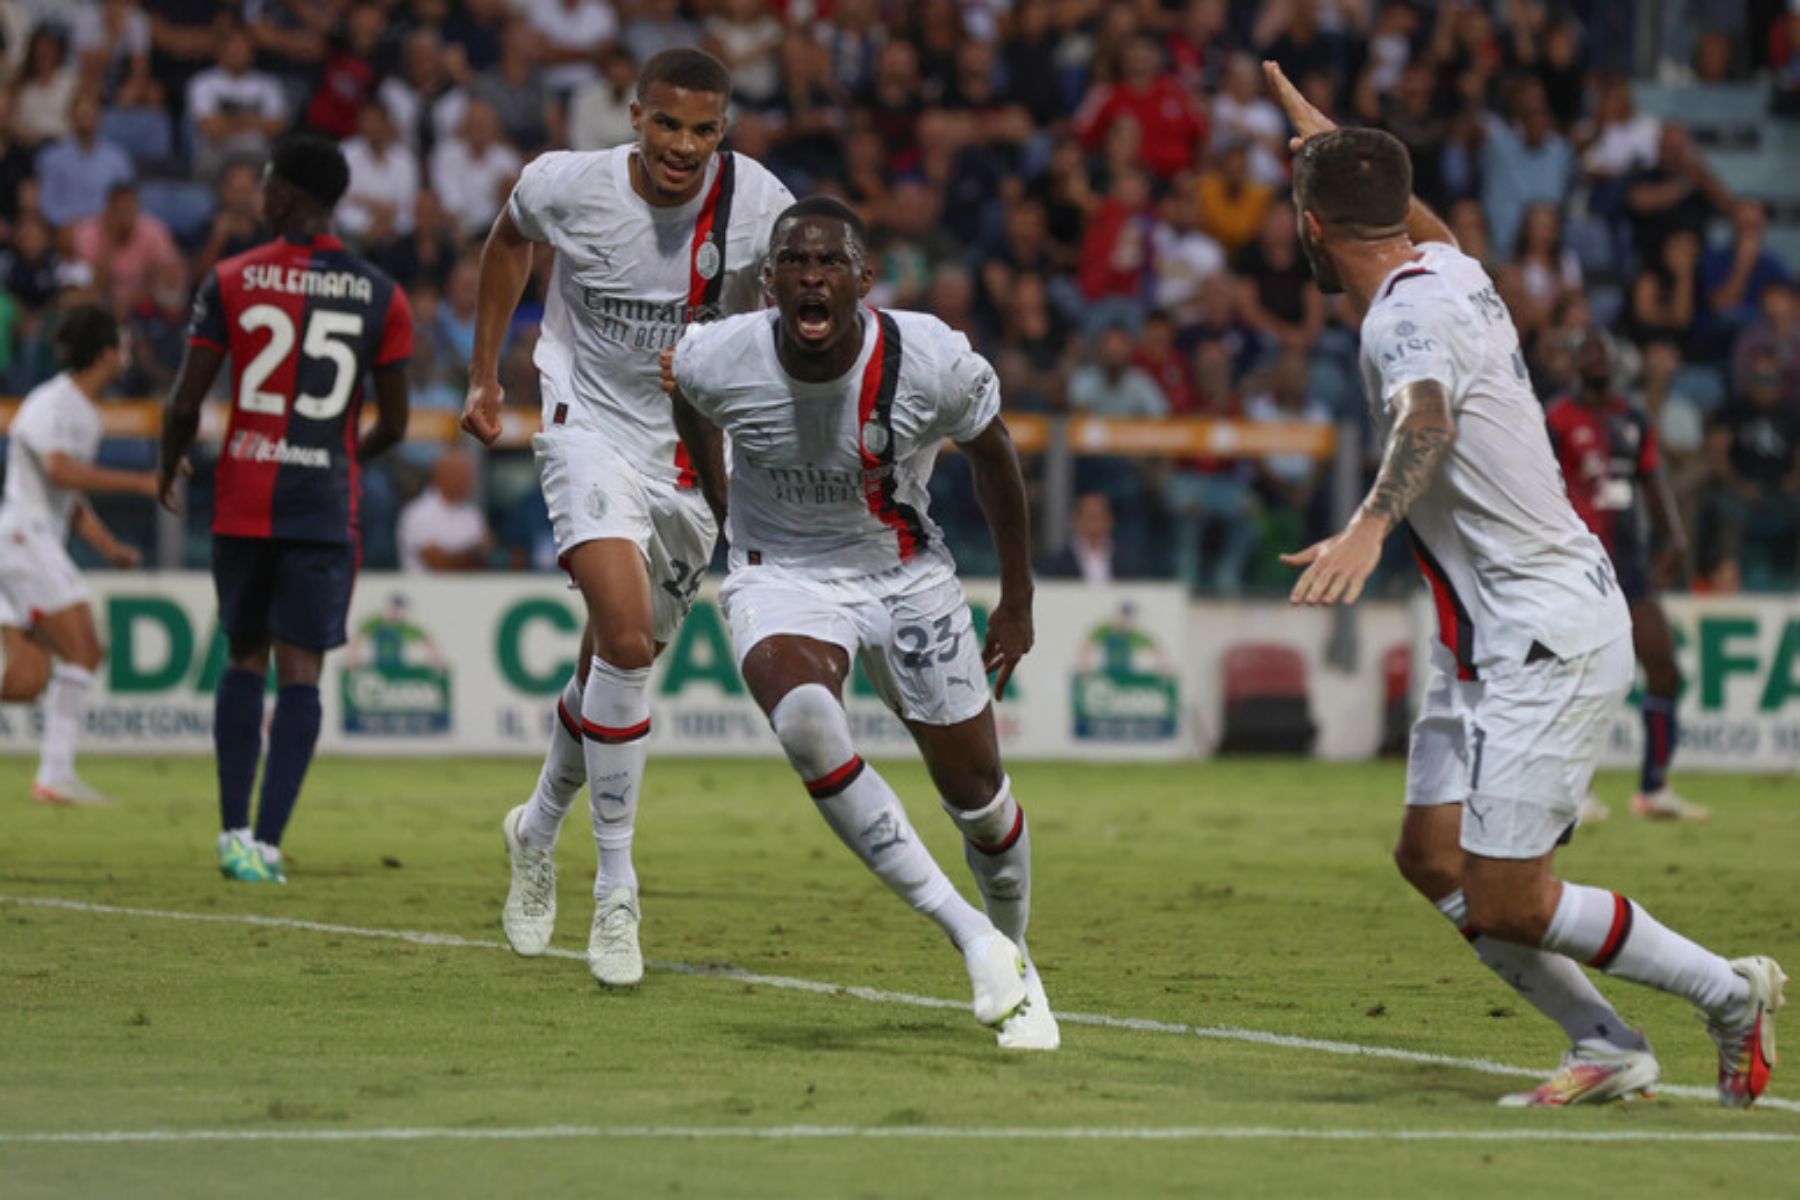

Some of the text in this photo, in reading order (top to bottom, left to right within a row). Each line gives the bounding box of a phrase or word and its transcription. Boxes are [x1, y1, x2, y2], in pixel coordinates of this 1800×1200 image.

[242, 265, 373, 303] SULEMANA
[239, 304, 363, 419] 25
[896, 614, 961, 669] 23
